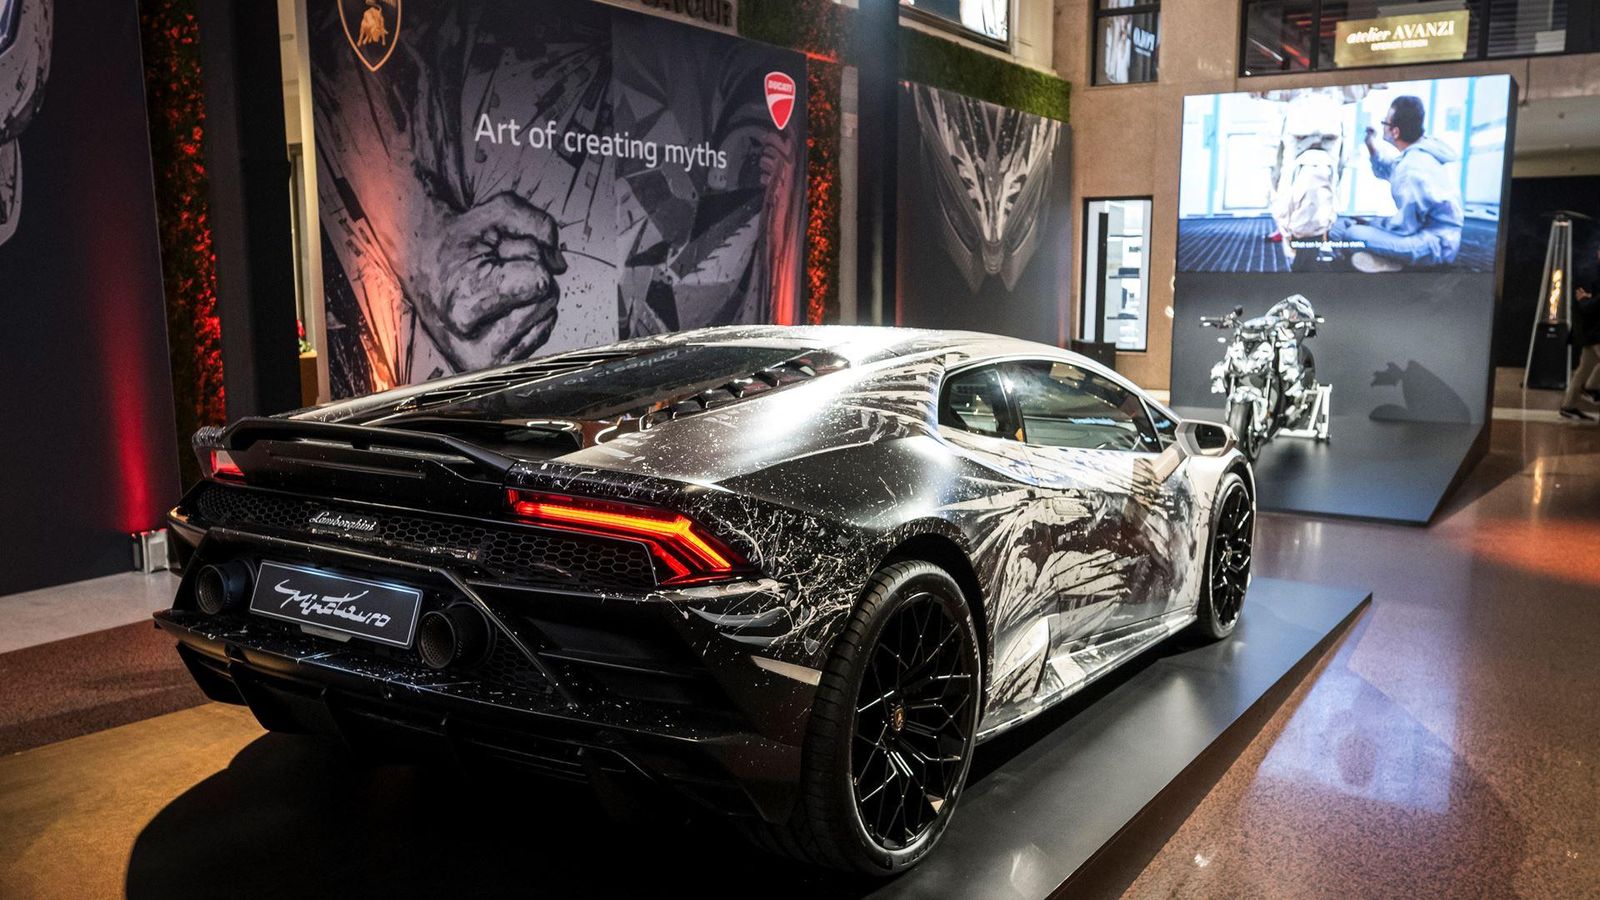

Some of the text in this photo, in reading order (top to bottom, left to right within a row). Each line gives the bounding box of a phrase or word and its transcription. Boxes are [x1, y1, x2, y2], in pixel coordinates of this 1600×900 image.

[1346, 20, 1455, 44] atelier AVANZI
[474, 113, 728, 172] Art of creating myths
[308, 511, 377, 532] Lamborghini
